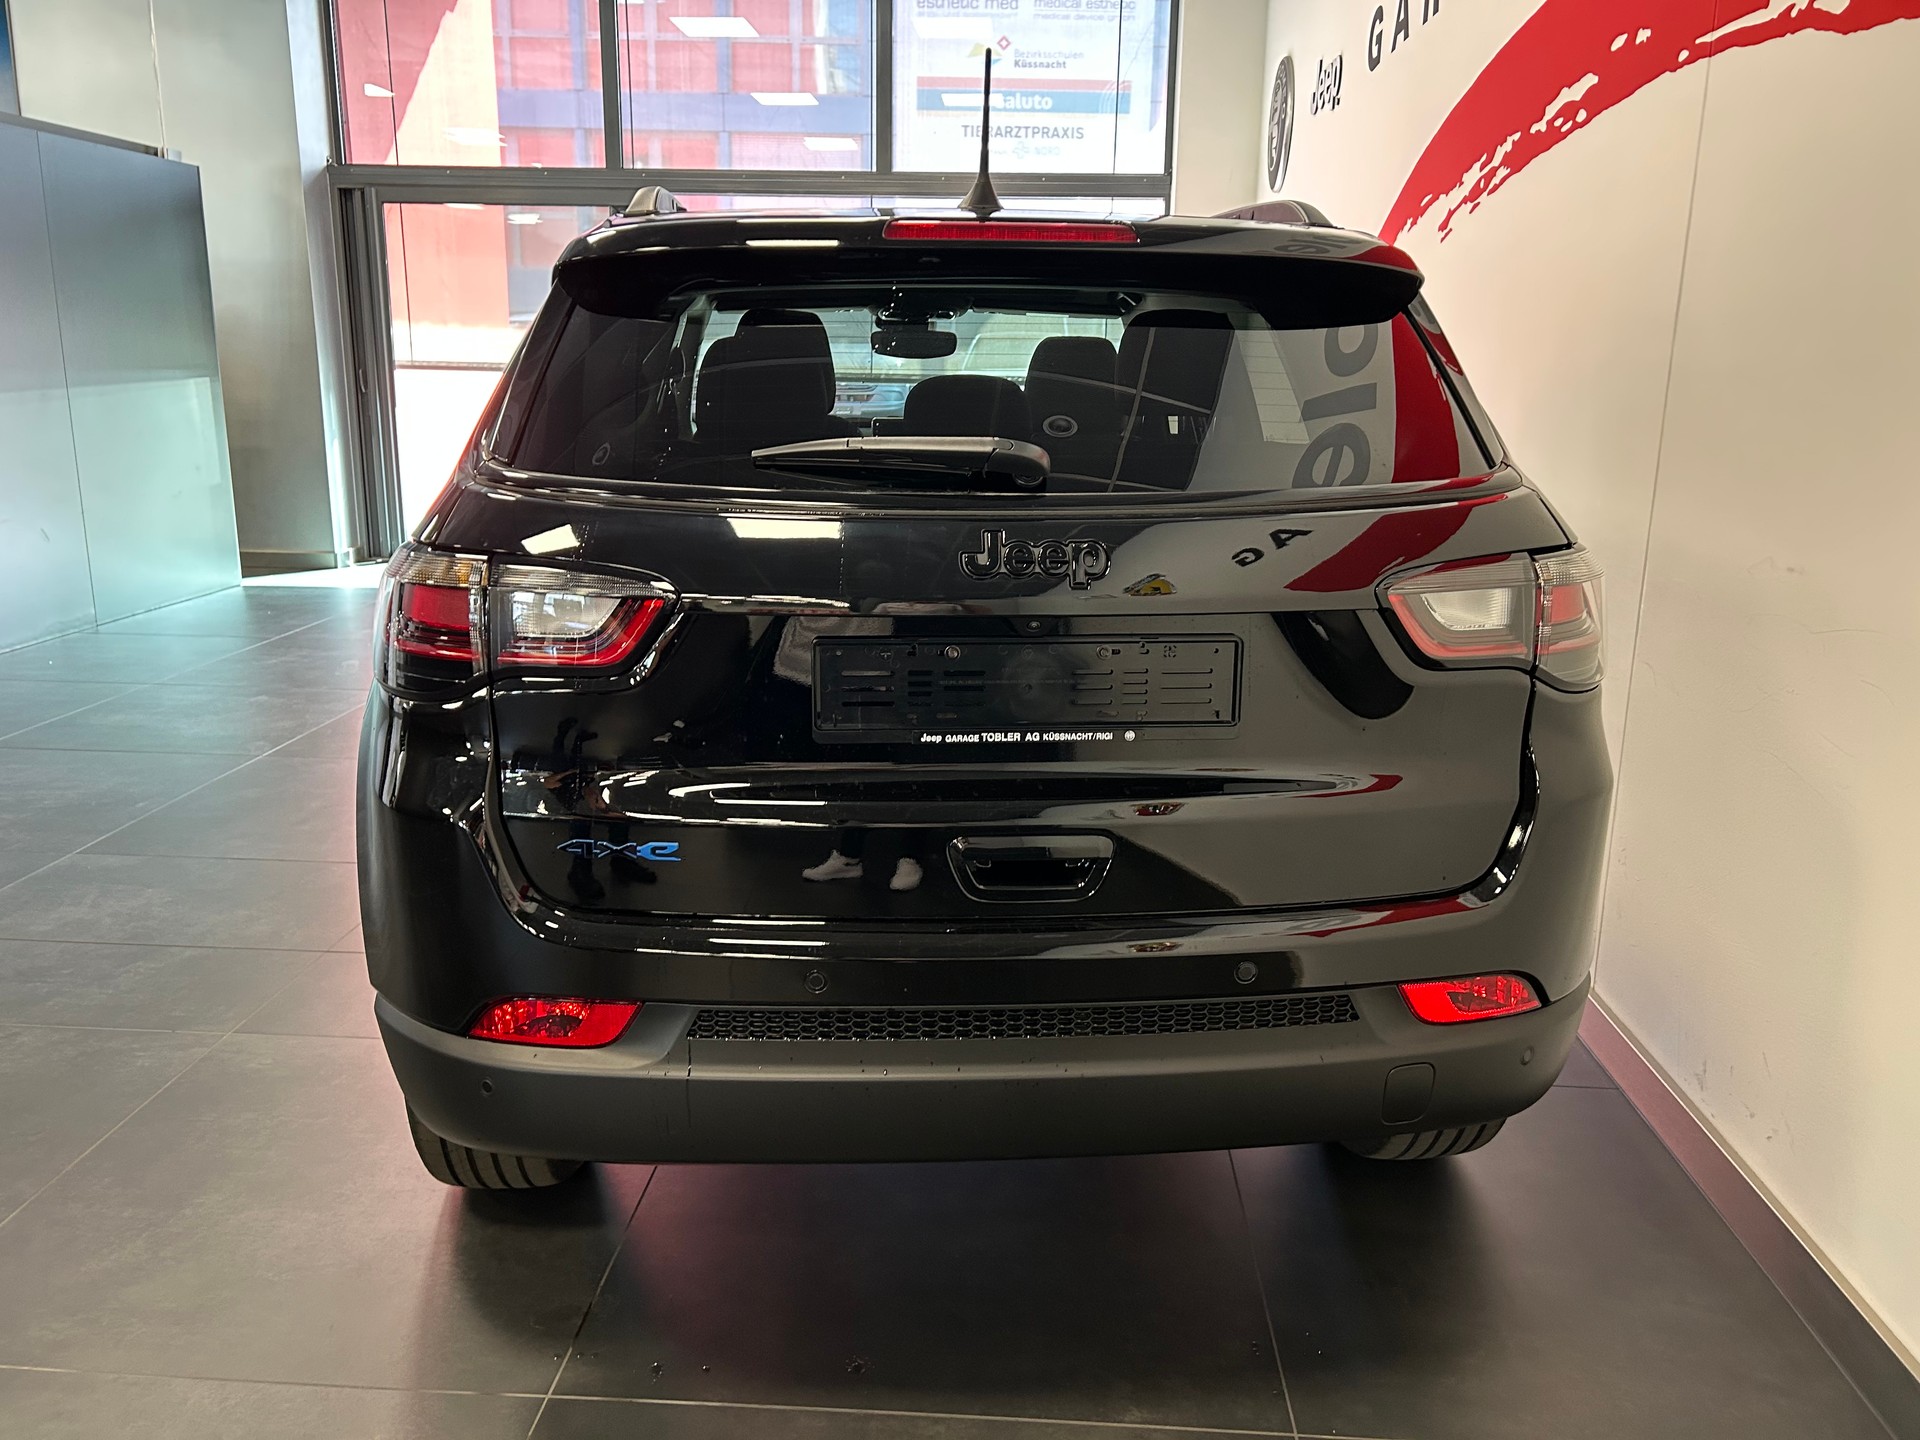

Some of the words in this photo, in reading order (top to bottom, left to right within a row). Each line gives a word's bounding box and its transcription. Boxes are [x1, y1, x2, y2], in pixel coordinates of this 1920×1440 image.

[1013, 58, 1067, 69] Küssnacht
[1310, 55, 1343, 116] Jeep
[961, 124, 1085, 140] TIERARZTPRAXIS
[959, 528, 1112, 590] Jeep
[920, 732, 943, 744] Jeep
[944, 733, 980, 743] GARAGE
[981, 732, 1021, 742] TOBLER
[1024, 731, 1041, 741] AG
